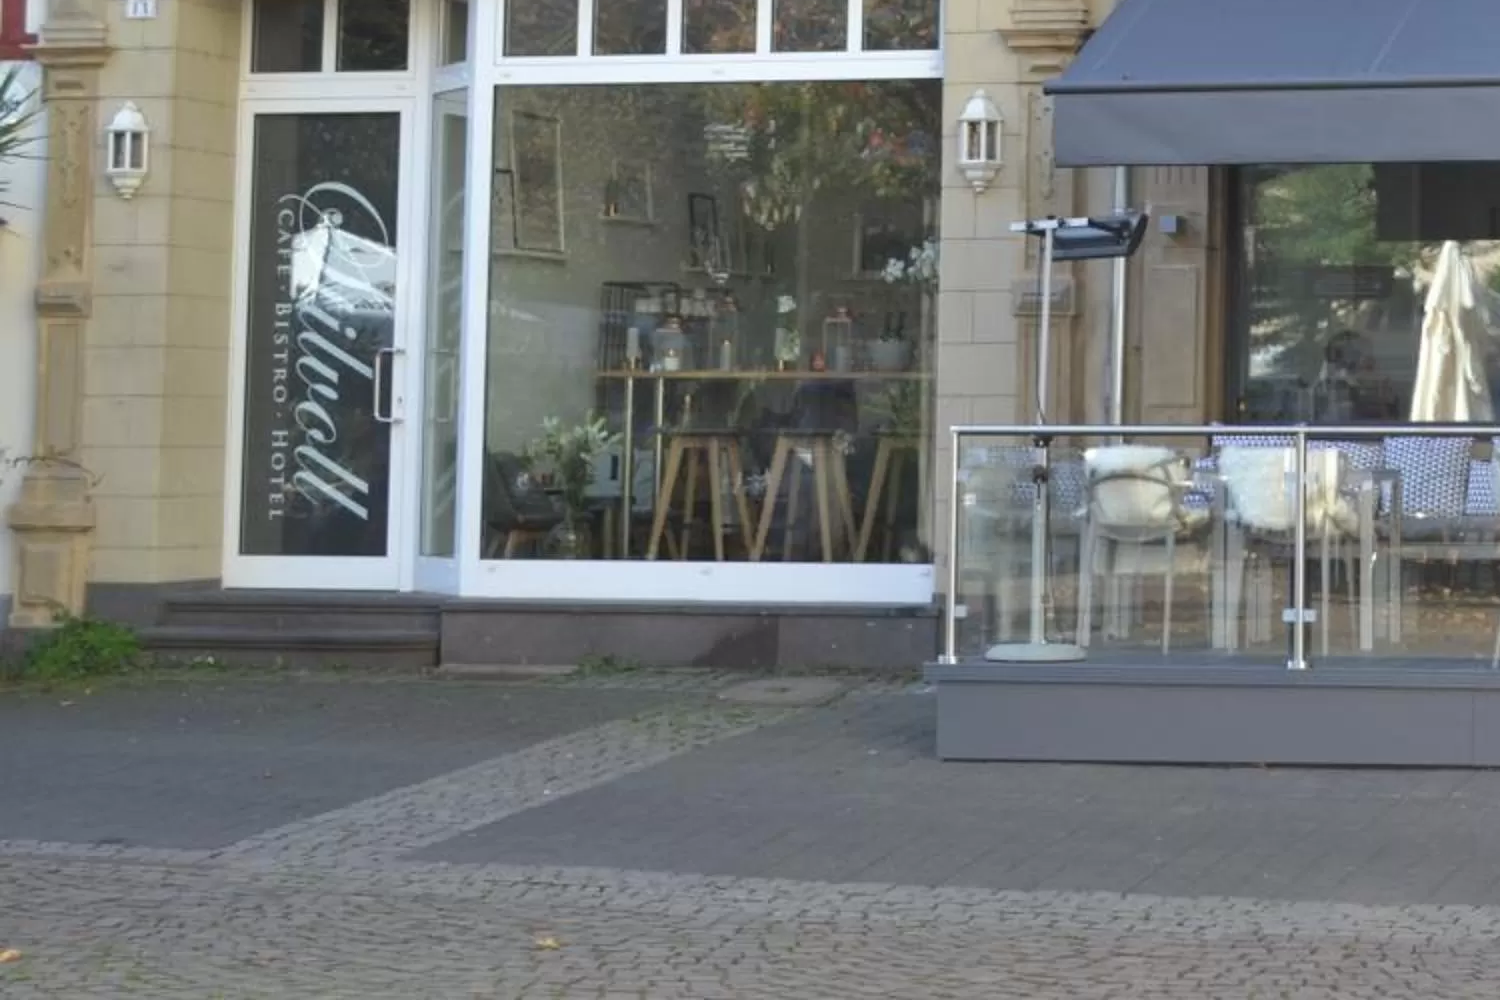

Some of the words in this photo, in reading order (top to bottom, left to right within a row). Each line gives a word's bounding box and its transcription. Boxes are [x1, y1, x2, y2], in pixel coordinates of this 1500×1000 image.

[274, 303, 292, 405] BISTRO
[279, 181, 388, 521] Silvoll
[268, 429, 289, 520] HOTEL
